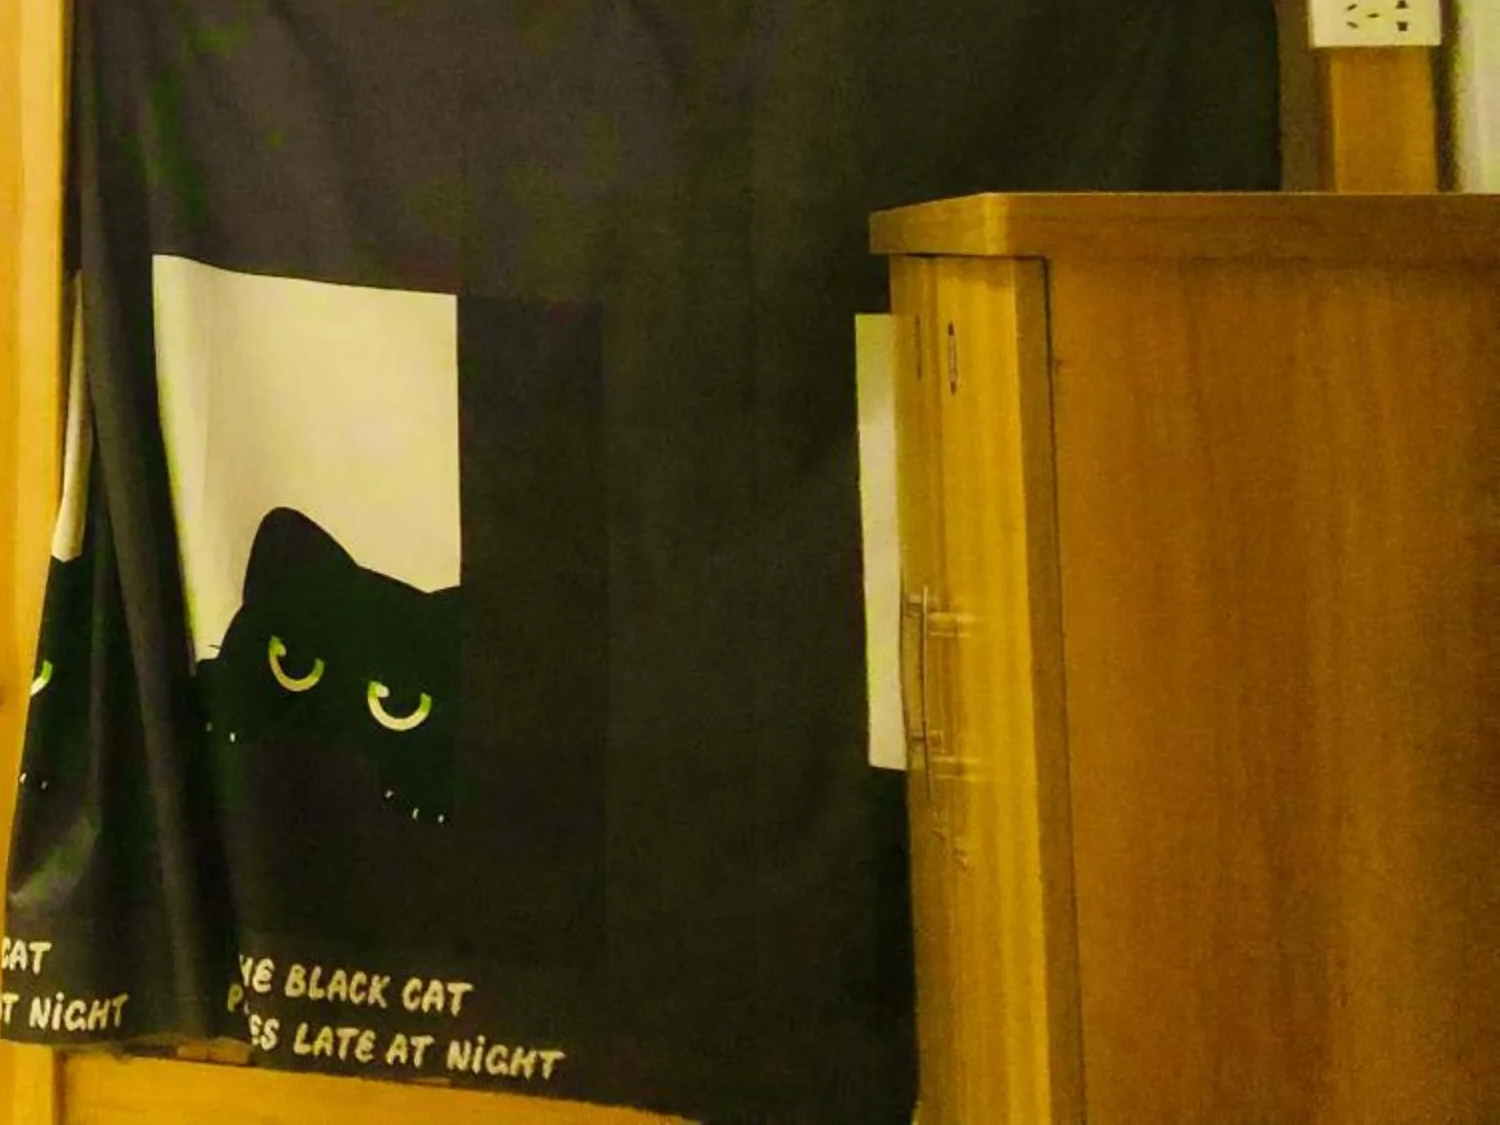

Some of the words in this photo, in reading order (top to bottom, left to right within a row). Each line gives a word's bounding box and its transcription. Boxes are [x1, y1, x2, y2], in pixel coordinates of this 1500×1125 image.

[284, 963, 391, 1009] BLACK
[402, 978, 474, 1016] CAT
[293, 1021, 376, 1064] LATE
[386, 1033, 435, 1069] AT
